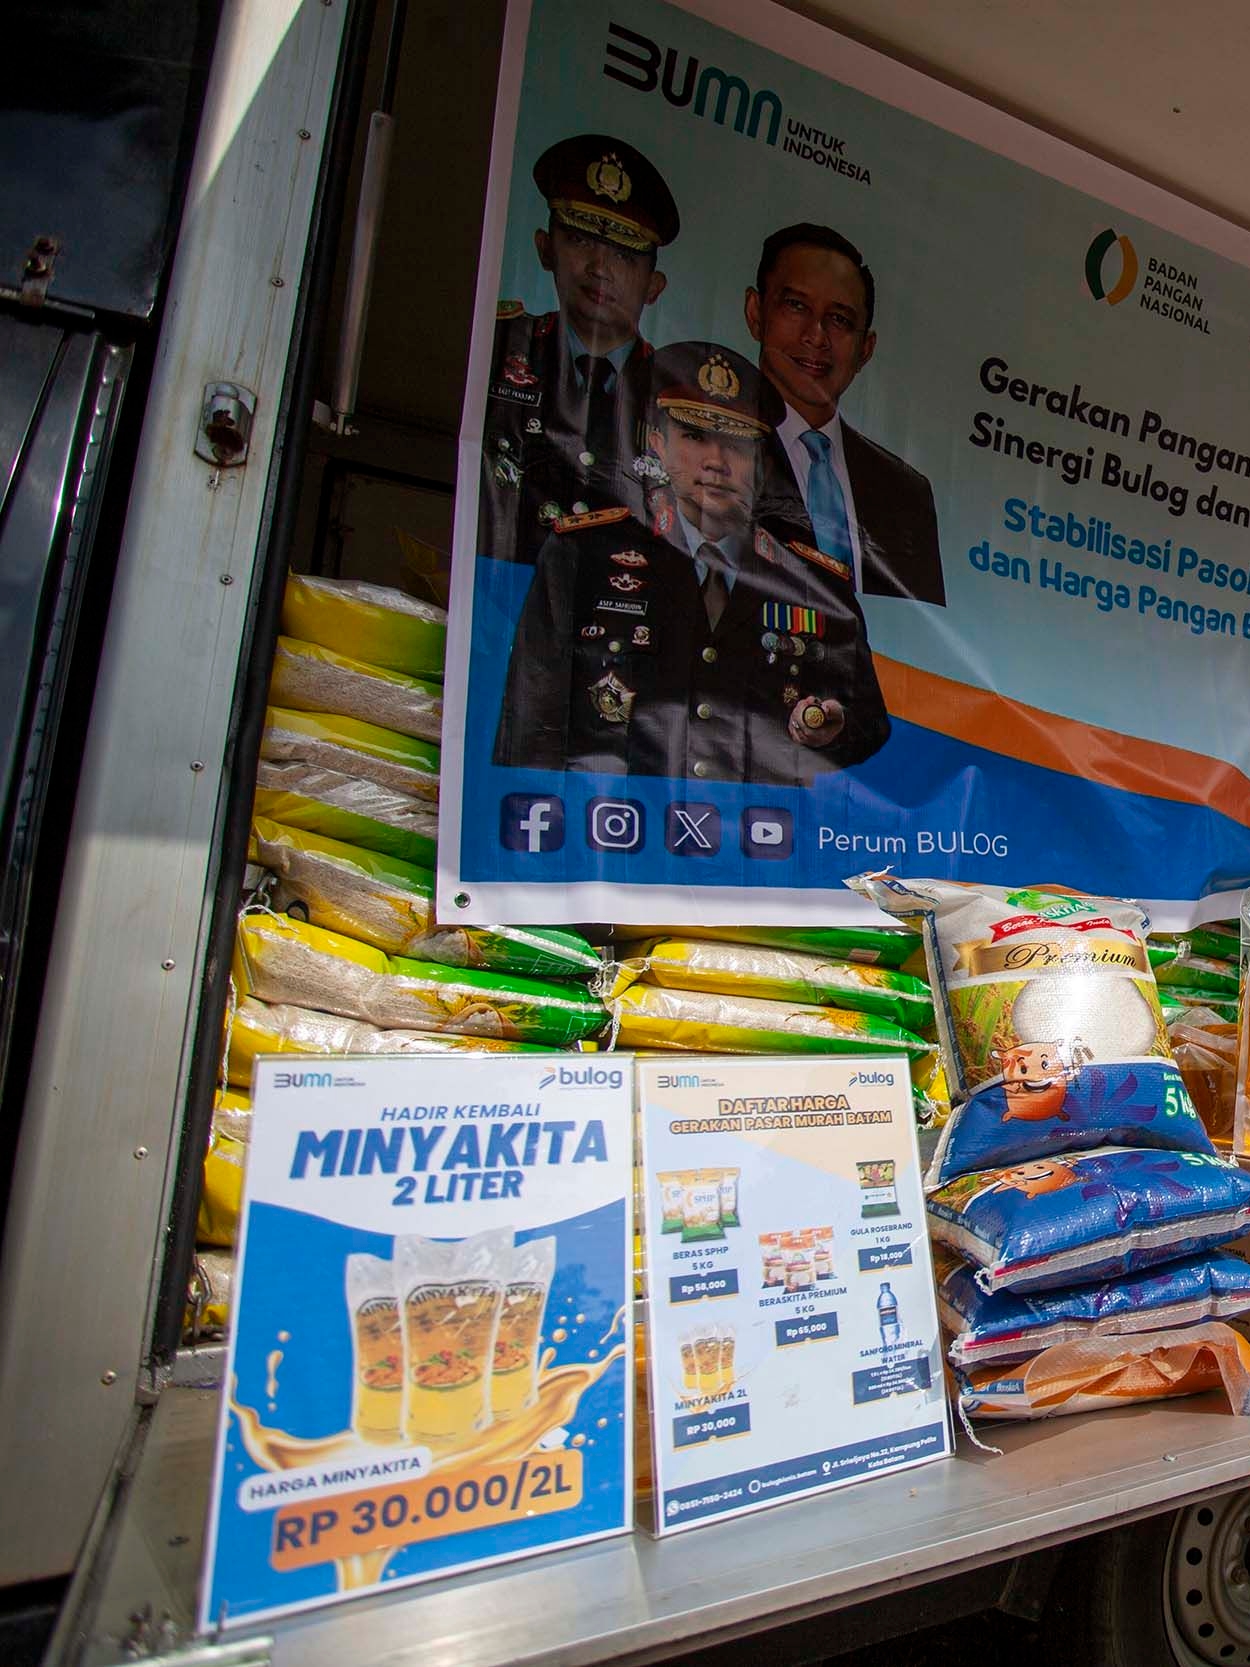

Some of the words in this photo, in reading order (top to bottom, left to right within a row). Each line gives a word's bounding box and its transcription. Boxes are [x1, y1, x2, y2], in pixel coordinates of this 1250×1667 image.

[603, 22, 782, 146] BUMN
[787, 118, 844, 155] UNTUK
[783, 137, 872, 185] INDONESIA
[1148, 257, 1197, 290] BADAN
[1144, 276, 1203, 311] PANGAN
[1140, 294, 1211, 335] NASIONAL
[979, 356, 1130, 437] Gerakan
[968, 411, 1095, 485] Sinergi
[1101, 452, 1188, 516] Bulog
[1196, 485, 1250, 528] dan
[1003, 497, 1171, 573] Stabilisasi
[968, 541, 1030, 584] dan
[1039, 558, 1130, 612] Harga
[1138, 585, 1236, 635] Pangan
[818, 826, 906, 854] Perum
[917, 831, 1008, 857] BULOG
[1003, 942, 1136, 970] Premium
[274, 1073, 332, 1088] BUMN
[559, 1067, 623, 1089] bulog
[657, 1075, 700, 1088] BUMN
[858, 1072, 894, 1086] bulog
[380, 1105, 448, 1121] HADIR
[453, 1103, 540, 1119] KEMBALI
[719, 1097, 791, 1116] DAFTAR
[790, 1095, 850, 1113] HARGA
[1165, 1087, 1178, 1116] 5
[670, 1119, 741, 1134] GERAKAN
[745, 1116, 792, 1131] PASAR
[795, 1113, 842, 1128] MURAH
[847, 1111, 893, 1125] BATAM
[289, 1119, 608, 1179] MINYAKITA
[1181, 1153, 1204, 1166] 5
[391, 1176, 417, 1205] 2
[424, 1170, 524, 1203] LITER
[850, 1228, 869, 1236] GULA
[870, 1222, 913, 1234] ROSEBRAND
[672, 1249, 703, 1260] BERAS
[704, 1246, 729, 1256] SPHP
[870, 1255, 880, 1263] Rp
[692, 1262, 698, 1271] 5
[699, 1261, 714, 1269] KG
[681, 1285, 695, 1295] Rp
[759, 1293, 807, 1307] BERASKITA
[808, 1287, 847, 1300] PREMIUM
[795, 1306, 801, 1314] 5
[802, 1304, 815, 1313] KG
[786, 1328, 798, 1338] Rp
[798, 1322, 827, 1334] 65,000
[894, 1339, 923, 1350] MINERAL
[882, 1353, 905, 1364] WATER
[674, 1391, 734, 1410] MINYAKITA
[736, 1388, 748, 1398] 2L
[686, 1425, 701, 1435] RP
[701, 1416, 736, 1432] 30,000
[890, 1441, 920, 1453] Kampung
[884, 1455, 905, 1464] Batam
[250, 1475, 315, 1500] HARGA
[322, 1456, 421, 1486] MINYAKITA
[275, 1509, 338, 1553] RP
[351, 1460, 572, 1537] 30.000/2L
